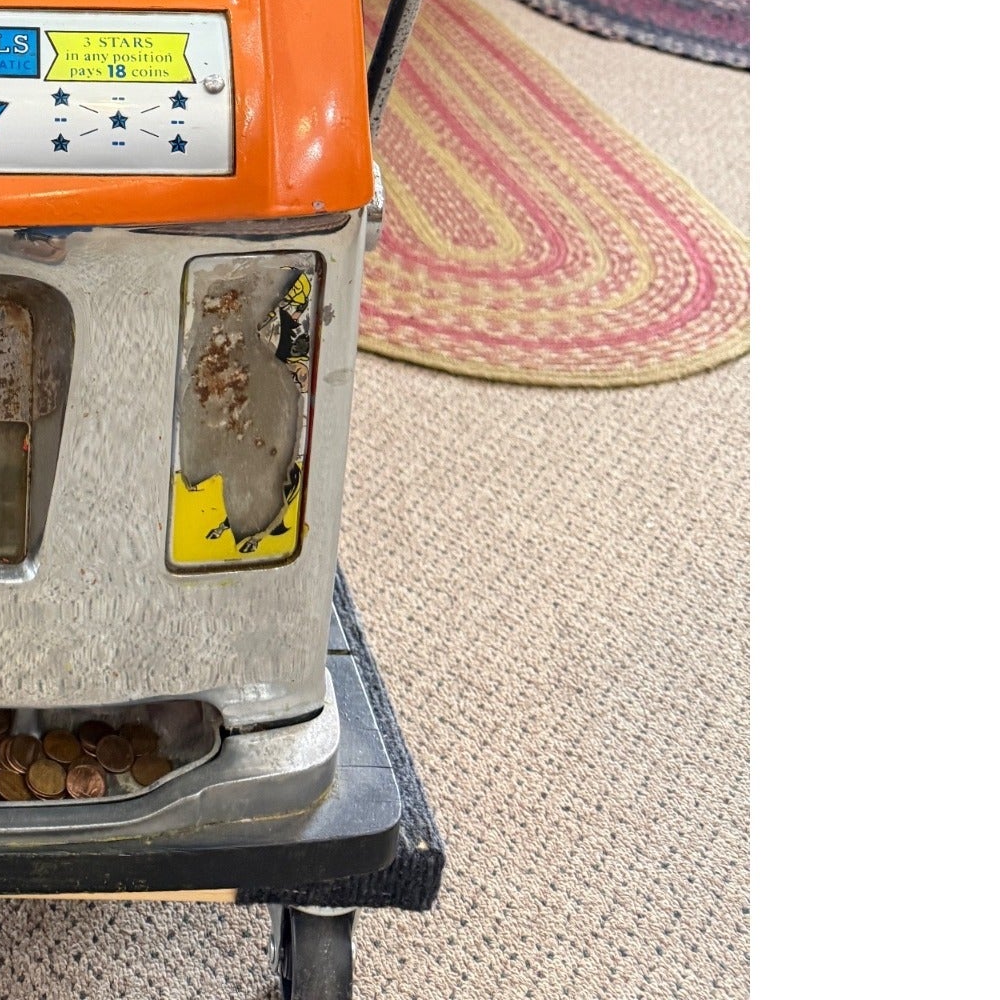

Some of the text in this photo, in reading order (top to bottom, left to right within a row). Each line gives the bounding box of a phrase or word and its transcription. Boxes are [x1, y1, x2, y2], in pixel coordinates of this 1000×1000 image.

[83, 37, 153, 48] 3 STARS
[66, 49, 172, 64] in any position
[70, 64, 169, 78] pays 18 coins
